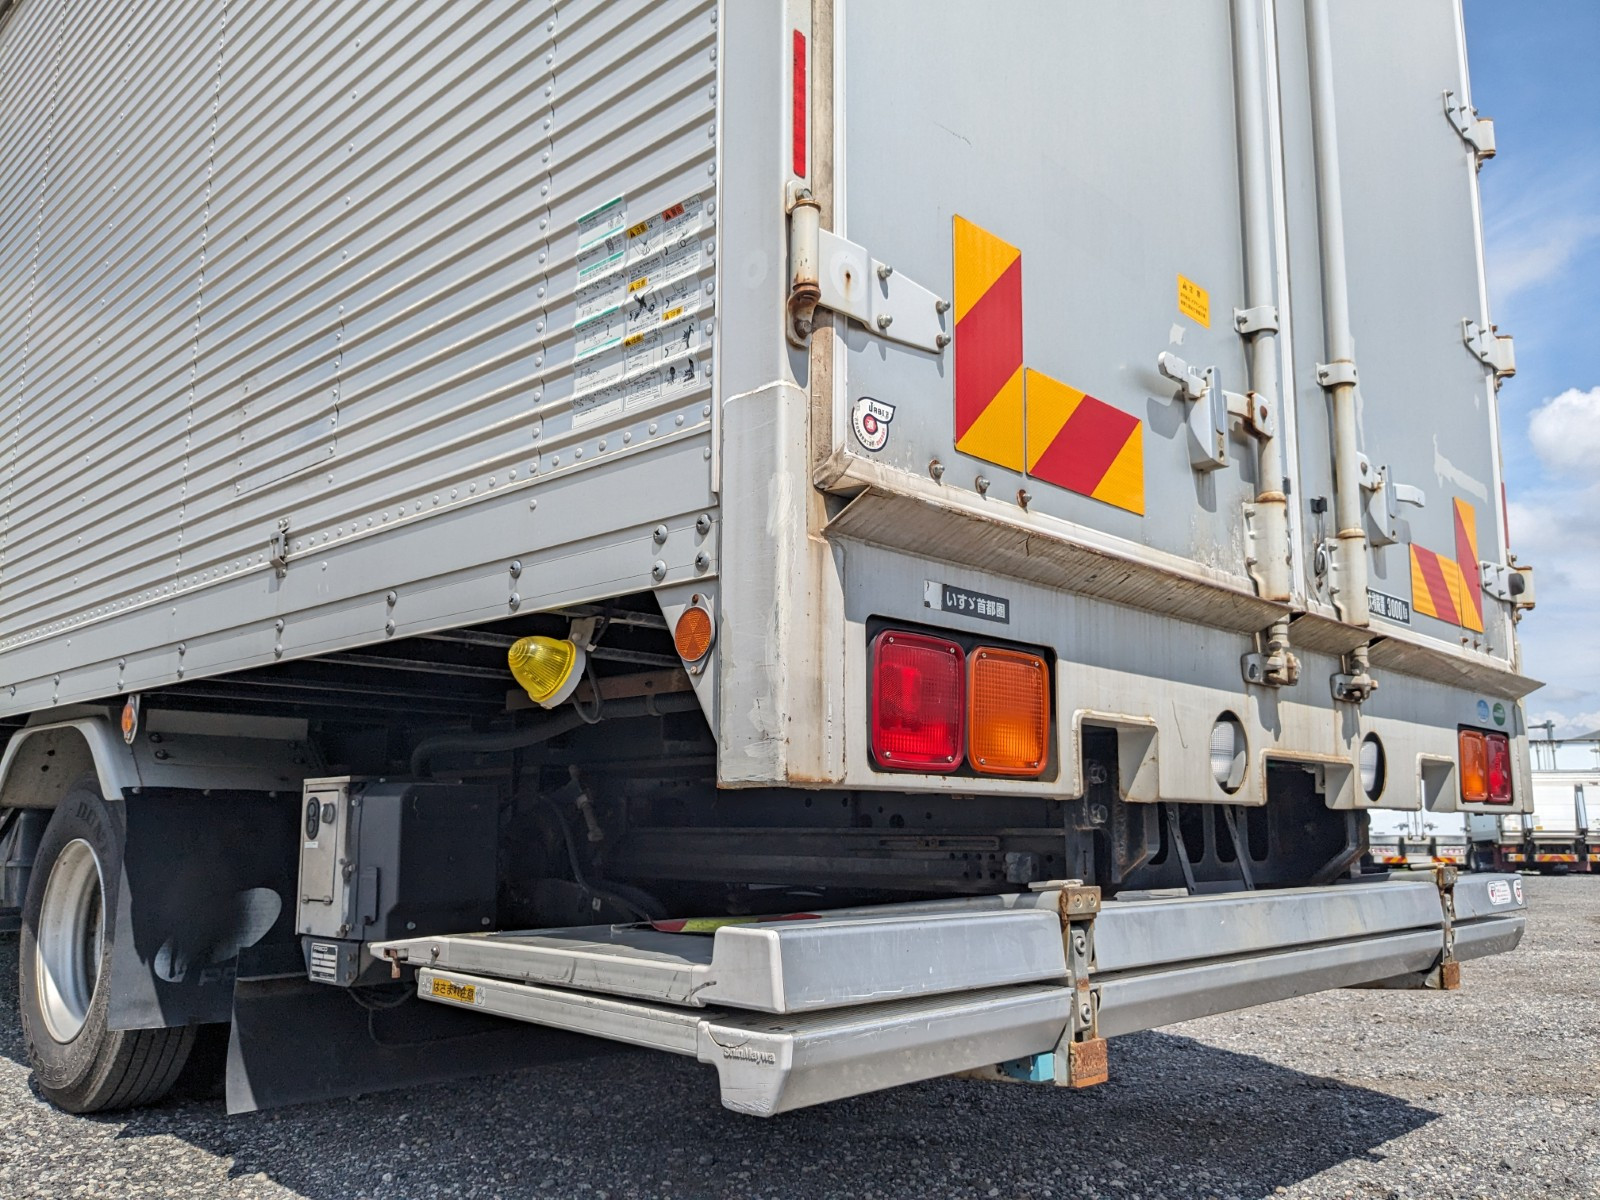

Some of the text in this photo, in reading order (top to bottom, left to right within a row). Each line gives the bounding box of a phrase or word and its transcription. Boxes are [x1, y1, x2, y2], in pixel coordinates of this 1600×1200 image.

[946, 591, 1006, 619] いすゞ首都圏
